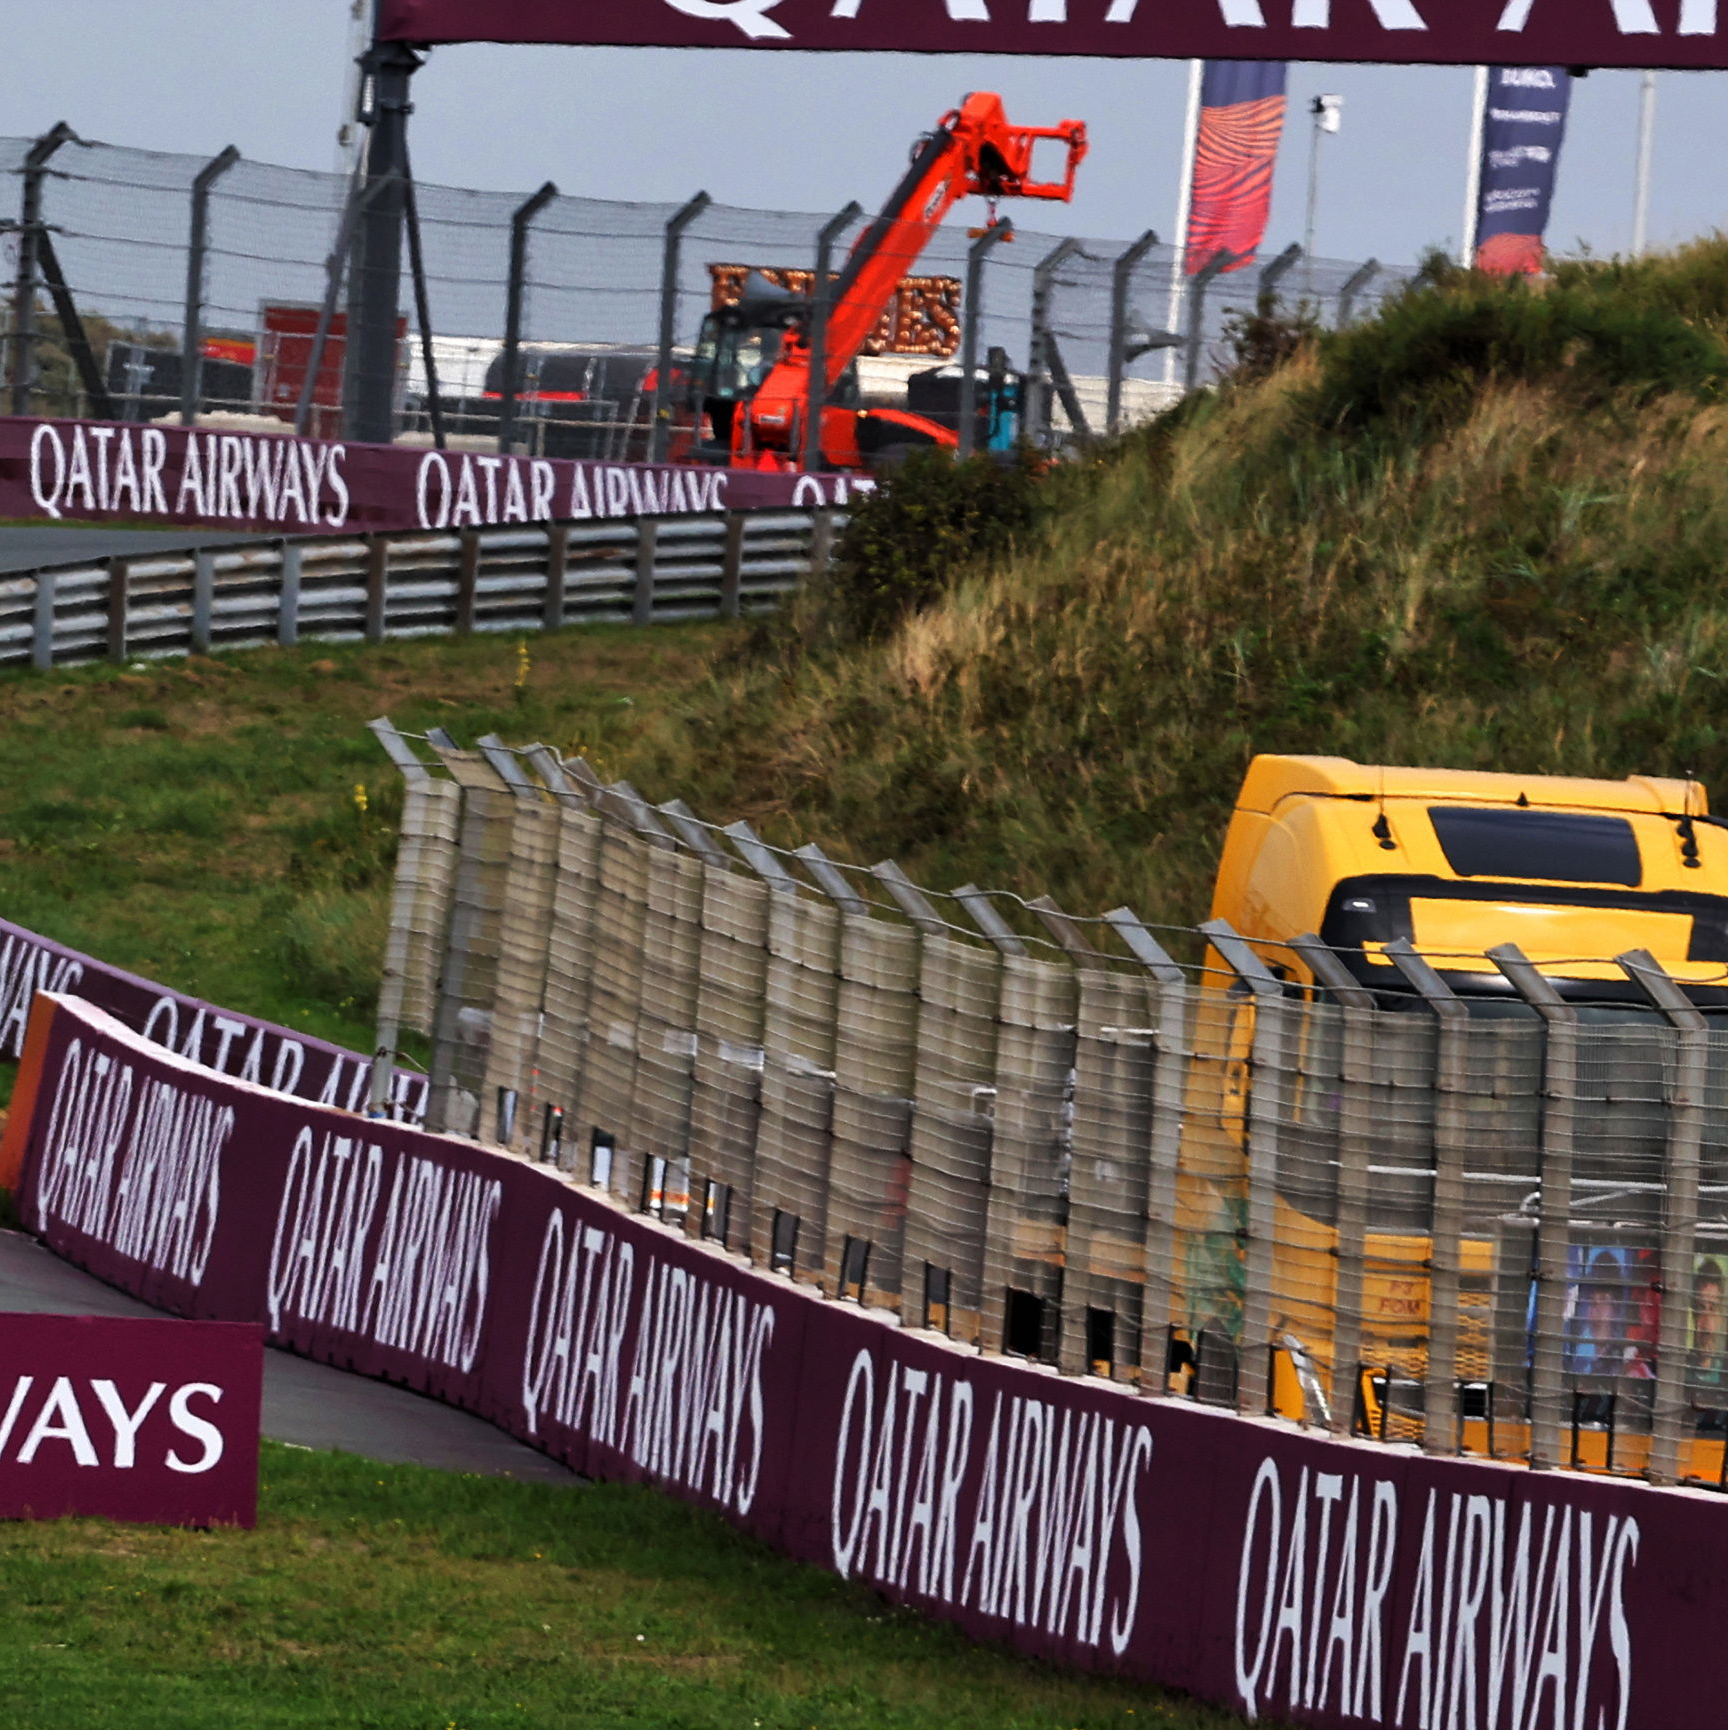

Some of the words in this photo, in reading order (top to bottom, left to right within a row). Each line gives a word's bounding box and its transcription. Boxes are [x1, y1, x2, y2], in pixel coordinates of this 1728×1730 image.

[30, 424, 168, 519] QATAR
[177, 434, 349, 527] AIRWAYS
[417, 451, 555, 529] QATAR
[38, 1038, 133, 1241] QATAR
[106, 1075, 235, 1287] AIRWAYS
[268, 1125, 383, 1333] QATAR
[361, 1151, 502, 1374] AIRWAYS
[522, 1207, 634, 1447] QATAR
[619, 1255, 774, 1516] AIRWAYS
[832, 1348, 973, 1603] QATAR
[961, 1390, 1152, 1657] AIRWAYS
[1235, 1457, 1397, 1722] QATAR
